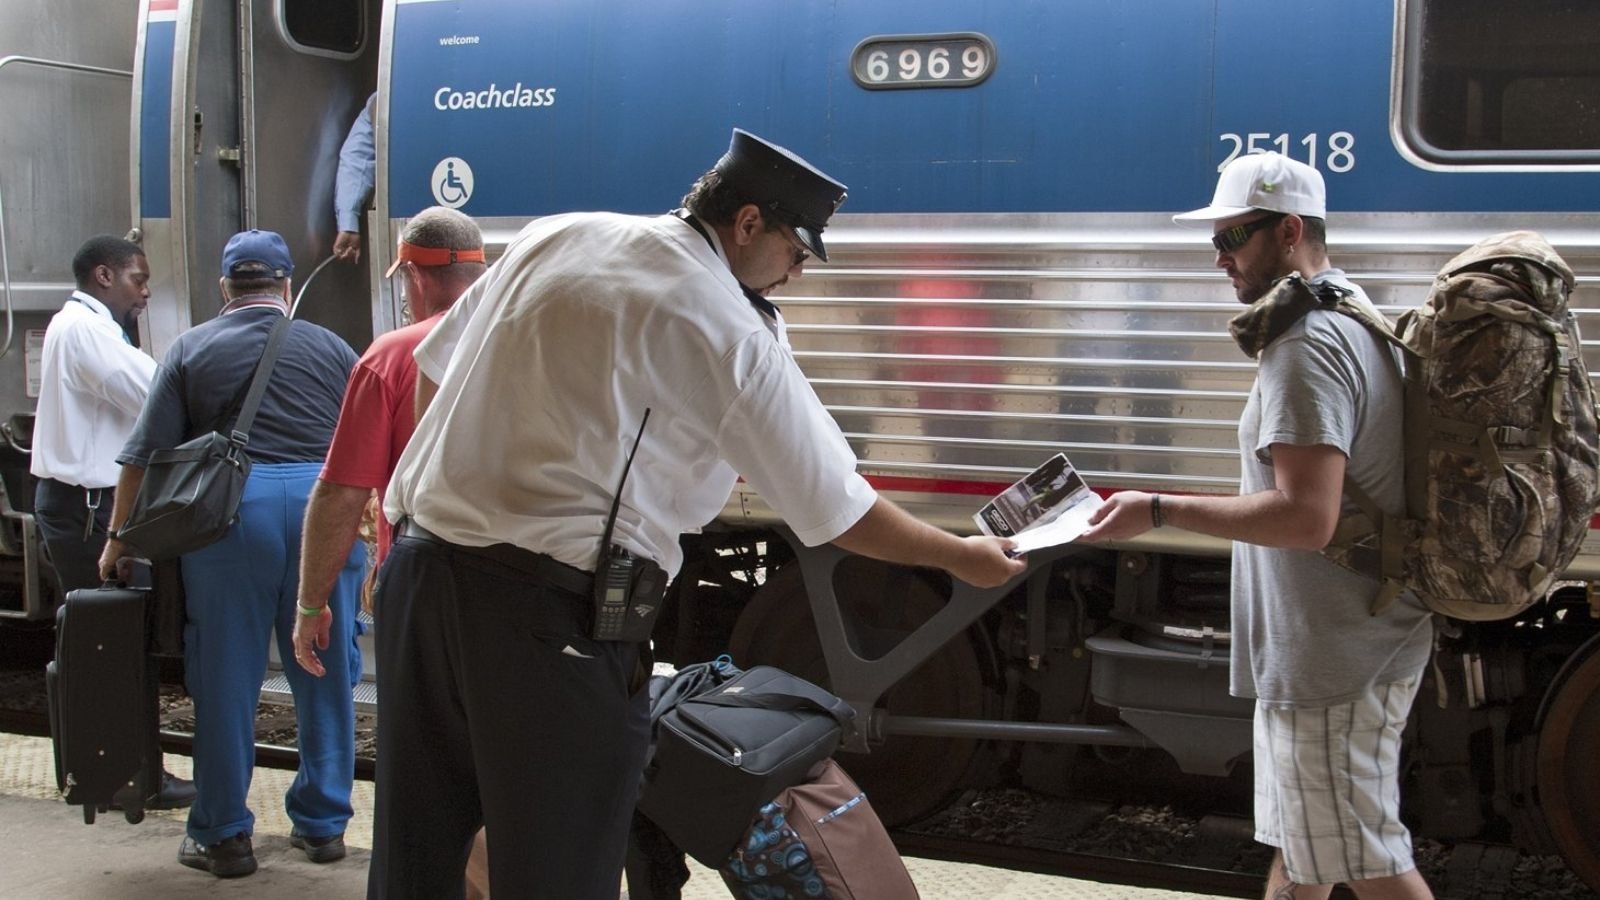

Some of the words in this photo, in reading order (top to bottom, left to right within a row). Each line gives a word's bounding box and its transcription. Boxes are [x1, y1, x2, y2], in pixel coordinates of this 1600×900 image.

[439, 35, 480, 46] welcome
[866, 46, 986, 81] 6969
[434, 82, 556, 110] Coachclass
